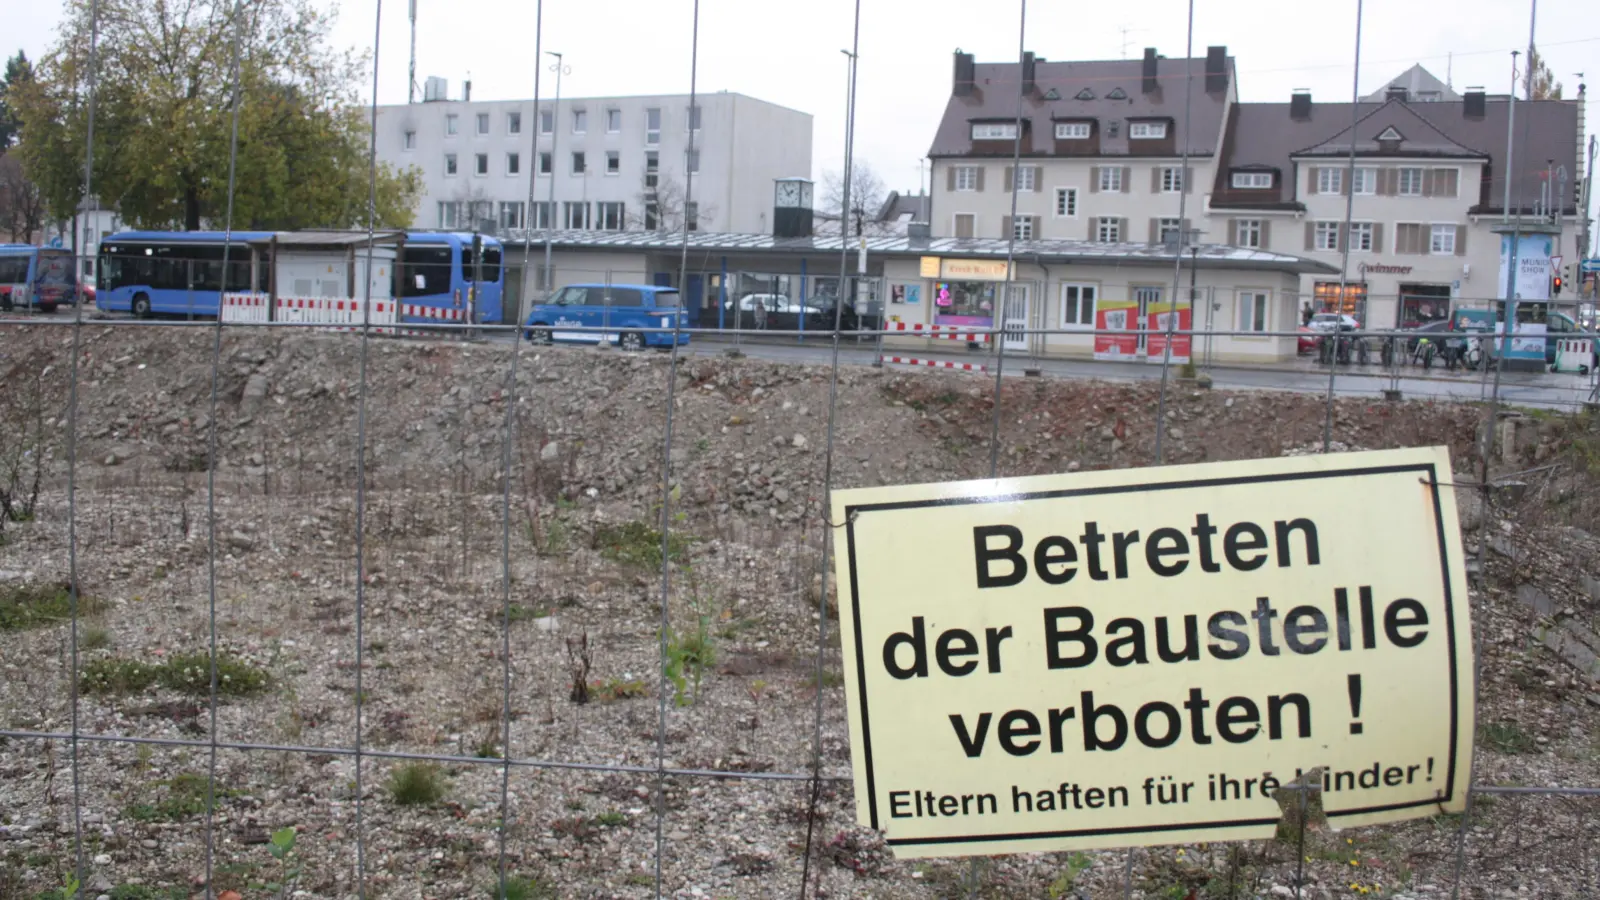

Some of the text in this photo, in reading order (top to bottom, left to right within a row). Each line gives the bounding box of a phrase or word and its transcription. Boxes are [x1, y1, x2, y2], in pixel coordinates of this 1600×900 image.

[1521, 266, 1545, 274] SHOW
[973, 513, 1321, 589] Betreten
[882, 585, 1429, 680] der Baustelle
[948, 673, 1363, 758] verboten !
[889, 756, 1435, 819] Eltern haften für ihre inder!
